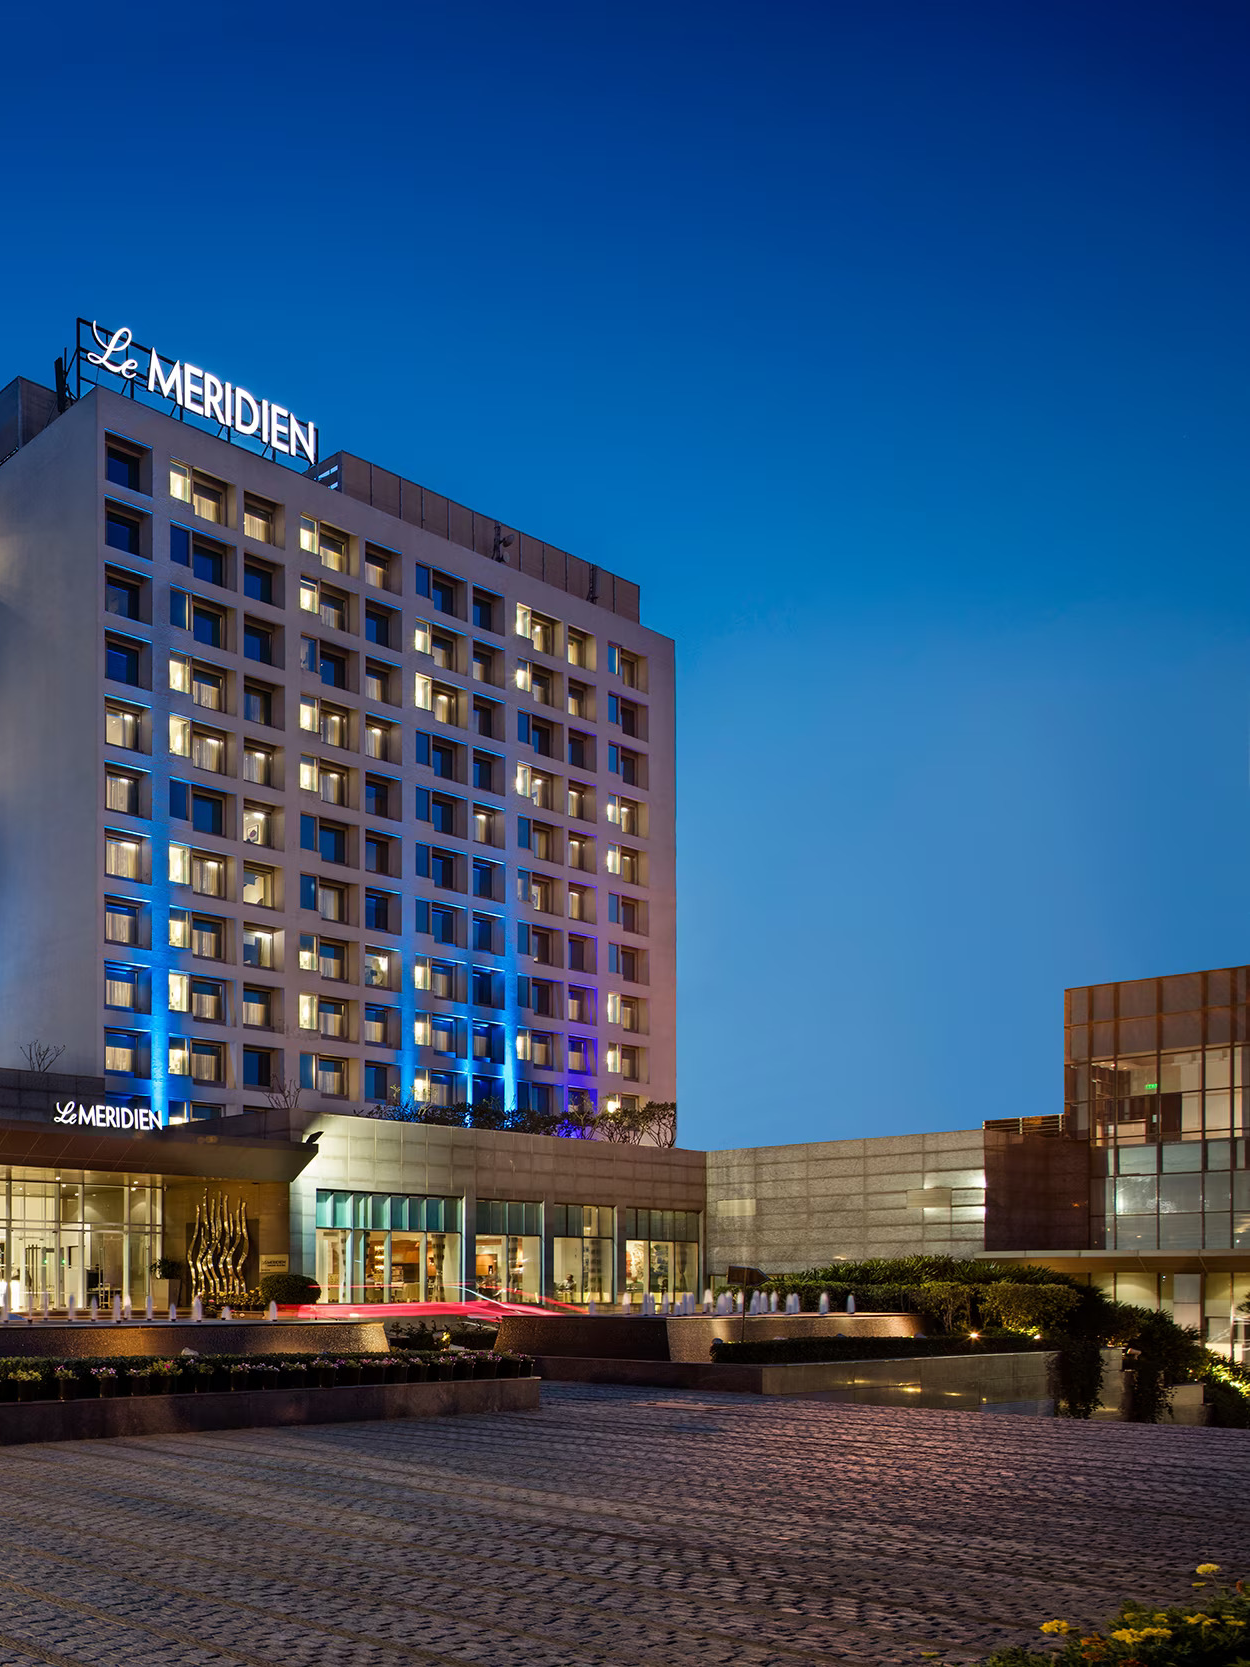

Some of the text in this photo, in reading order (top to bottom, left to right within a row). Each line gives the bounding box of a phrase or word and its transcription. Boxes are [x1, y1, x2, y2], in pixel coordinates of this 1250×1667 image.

[87, 320, 315, 465] Le MERIDIEN
[53, 1101, 163, 1130] Le MERIDIEN
